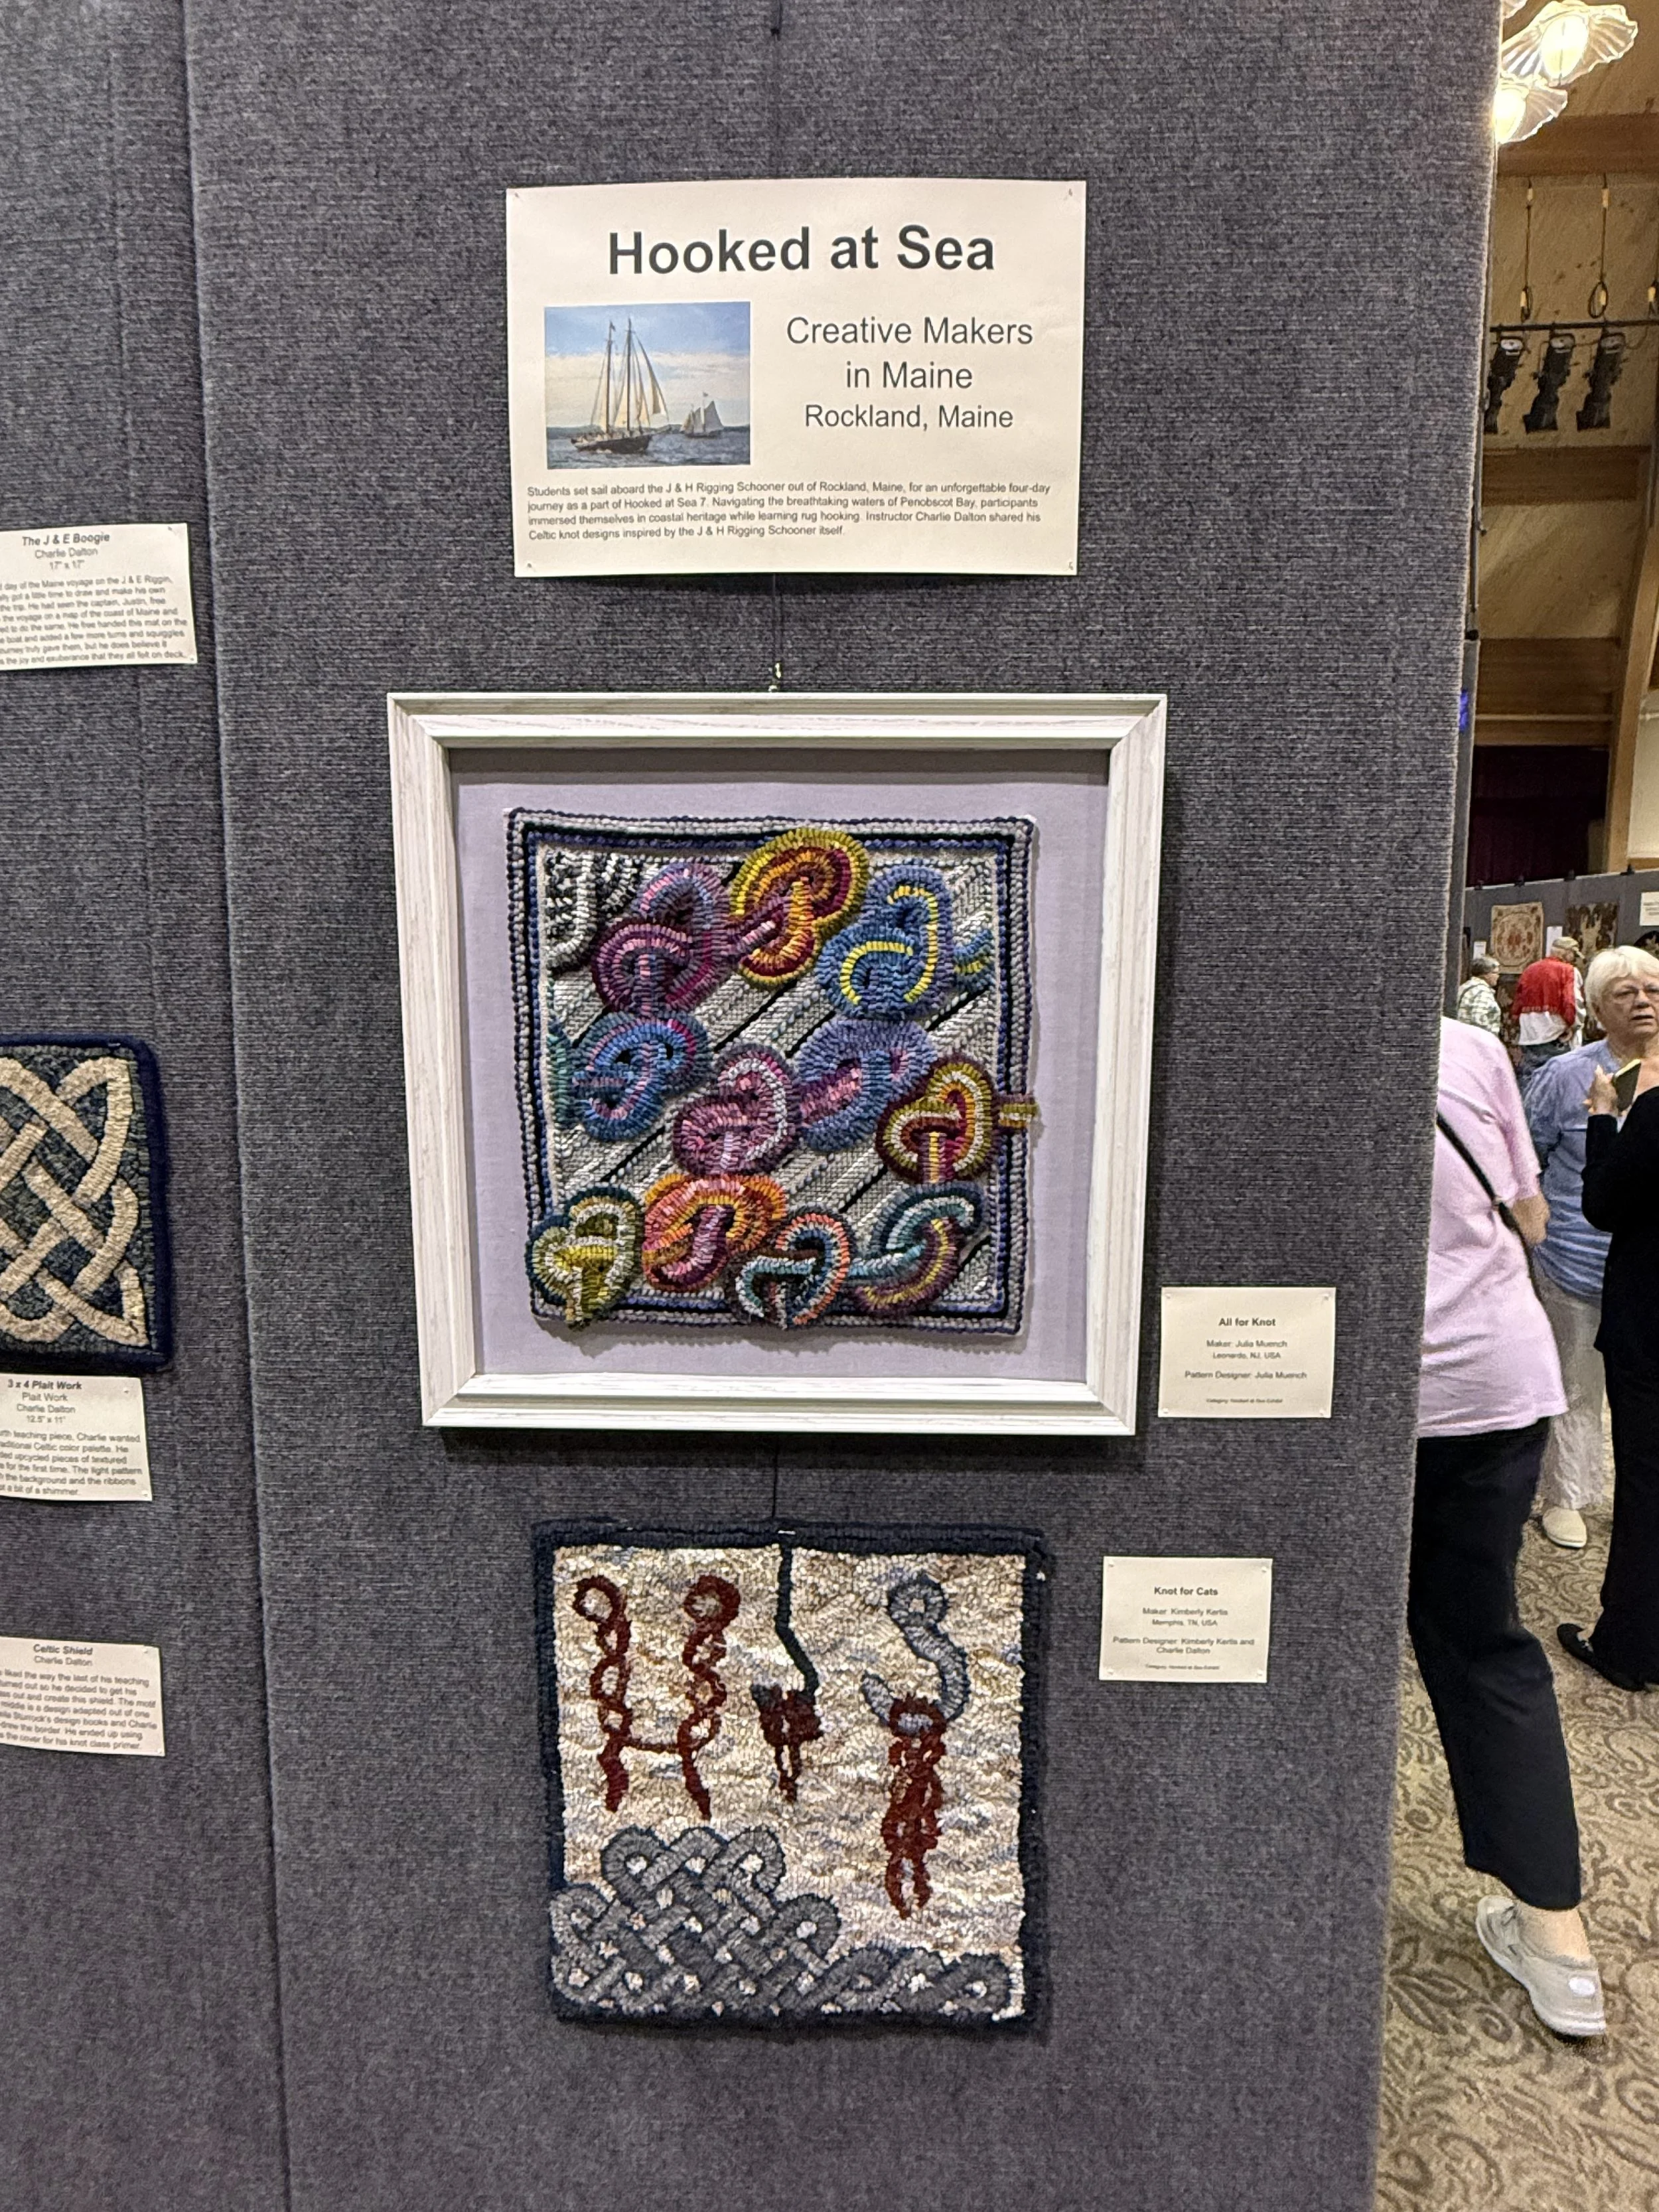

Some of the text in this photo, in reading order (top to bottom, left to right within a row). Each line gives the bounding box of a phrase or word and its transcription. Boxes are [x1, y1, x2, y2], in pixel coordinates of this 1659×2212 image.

[609, 225, 994, 274] Hooked at Sea
[787, 316, 1032, 344] Creative Makers
[847, 362, 972, 388] in Maine
[939, 404, 1013, 426] Maine
[527, 486, 570, 496] Students
[573, 486, 588, 495] set
[591, 485, 607, 494] sail
[611, 484, 644, 494] aboard
[648, 484, 662, 493] the
[666, 484, 671, 493] J
[675, 484, 682, 492] &
[685, 483, 693, 492] H
[696, 482, 733, 494] Rigging
[737, 482, 784, 492] Schooner
[788, 482, 804, 491] out
[806, 482, 816, 491] of
[909, 482, 922, 490] for
[941, 482, 1006, 494] unforgettable
[1009, 482, 1050, 494] four-day
[528, 500, 563, 512] journey
[591, 499, 609, 511] part
[612, 499, 621, 508] of
[624, 498, 662, 508] Hooked
[665, 498, 674, 507] at
[677, 498, 697, 507] Sea
[712, 496, 764, 508] Navigating
[768, 496, 783, 506] the
[786, 497, 848, 508] breathtaking
[851, 497, 885, 506] waters
[888, 497, 897, 506] of
[900, 497, 953, 506] Penobscot
[981, 497, 1038, 508] participants
[528, 514, 576, 524] immersed
[579, 514, 634, 524] themselves
[637, 514, 645, 522] in
[649, 513, 684, 522] coastal
[687, 512, 726, 524] heritage
[729, 512, 755, 521] while
[758, 511, 798, 523] learning
[801, 513, 817, 522] rug
[866, 511, 912, 520] Instructor
[915, 511, 950, 520] Charlie
[954, 512, 986, 520] Dalton
[989, 512, 1023, 521] shared
[1026, 512, 1041, 521] his
[23, 534, 109, 546] The J & E Boogie
[528, 529, 555, 538] Celtic
[559, 529, 579, 538] knot
[582, 528, 620, 540] designs
[622, 528, 661, 539] inspired
[664, 527, 676, 538] by
[678, 527, 694, 536] the
[697, 527, 702, 536] J
[705, 526, 713, 536] &
[717, 526, 723, 536] H
[727, 526, 764, 538] Rigging
[768, 525, 816, 534] Schooner
[1180, 1587, 1193, 1595] for
[33, 1644, 93, 1655] Celtic Shield
